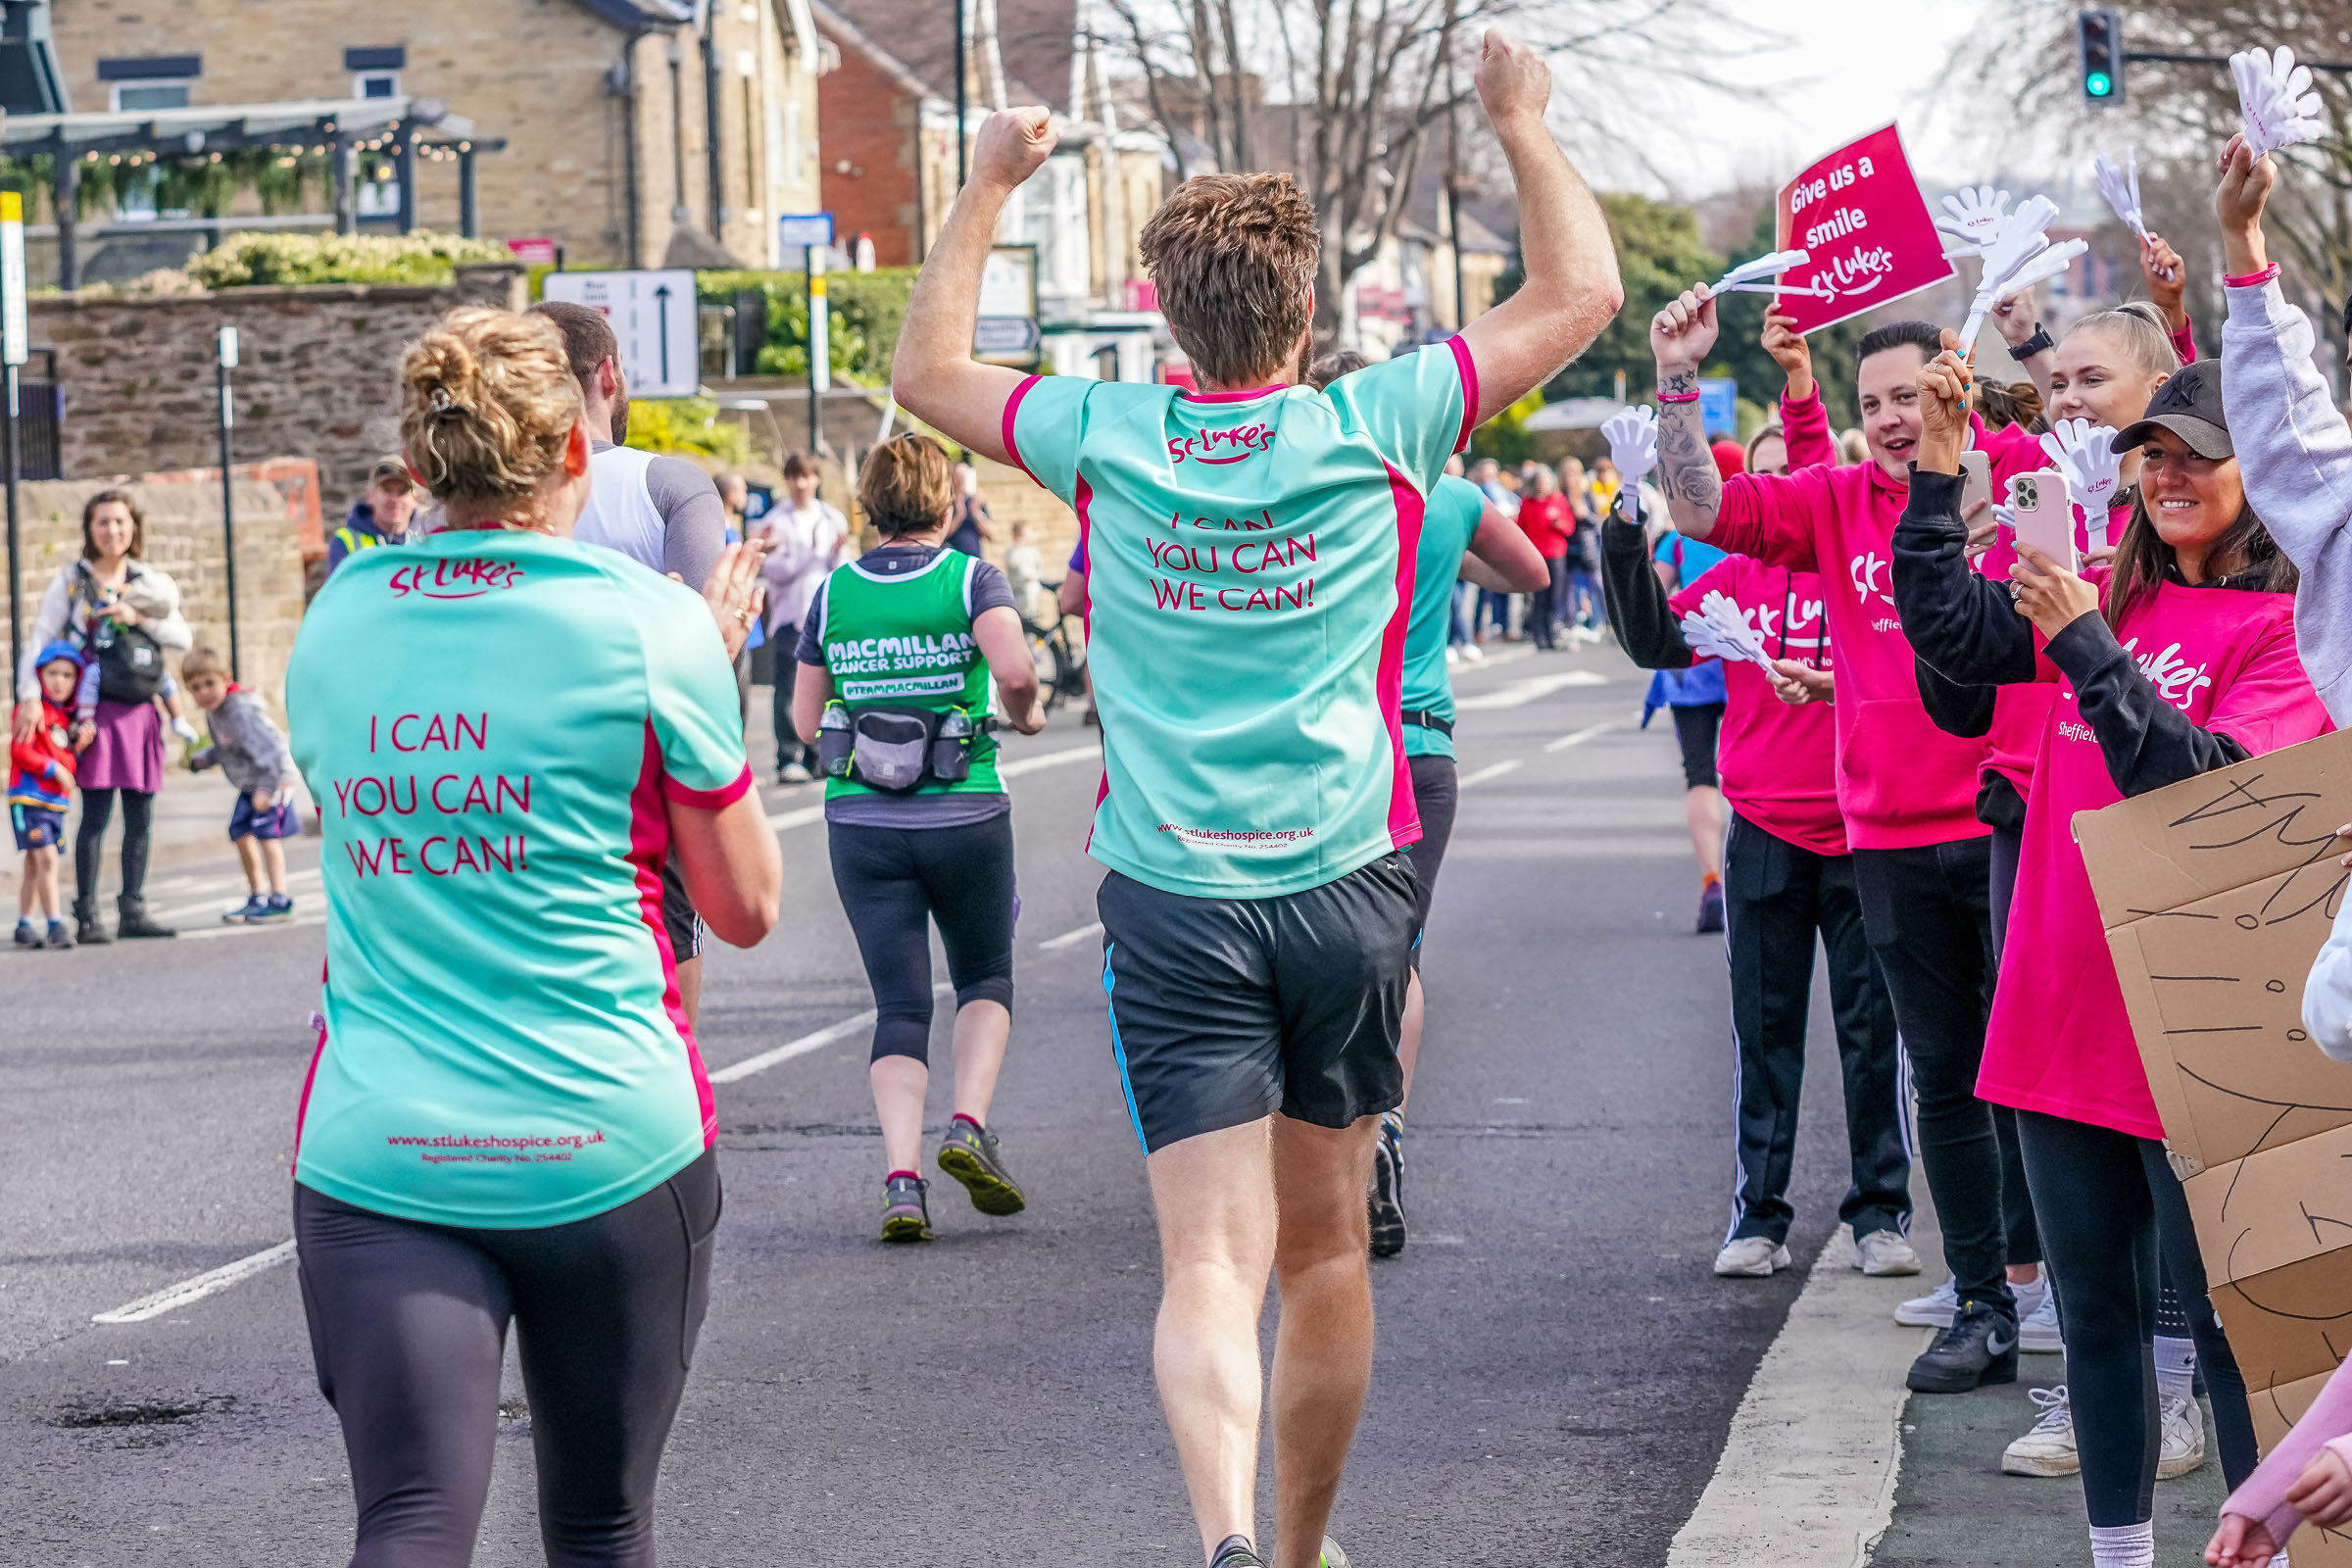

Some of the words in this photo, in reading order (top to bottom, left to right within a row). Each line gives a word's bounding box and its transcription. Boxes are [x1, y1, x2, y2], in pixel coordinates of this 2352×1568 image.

[1789, 177, 1827, 215] Give
[1830, 164, 1855, 191] us
[1858, 156, 1874, 178] a
[1806, 207, 1868, 249] smile
[1811, 270, 1839, 304] St
[1833, 246, 1893, 284] Luke's
[1168, 437, 1201, 464] St
[1200, 423, 1276, 452] Luke's
[1146, 537, 1218, 573] YOU
[1231, 533, 1317, 573] CAN
[389, 564, 431, 599] St
[434, 557, 524, 589] Luke's
[1149, 578, 1206, 611] WE
[1218, 578, 1314, 612] CAN!
[828, 632, 977, 662] MACMILLAN
[832, 660, 889, 674] CANCER
[894, 650, 973, 669] SUPPORT
[370, 714, 377, 753] I
[391, 712, 488, 752] CAN
[333, 774, 417, 818] YOU
[432, 774, 530, 814] CAN
[1156, 823, 1314, 842] www.stlukeshospice.org.uk
[345, 837, 414, 879] WE
[420, 835, 528, 876] CAN!
[387, 1129, 606, 1151] www.stlukeshospice.org.uk
[421, 1152, 472, 1164] Registered
[475, 1153, 512, 1164] Charity
